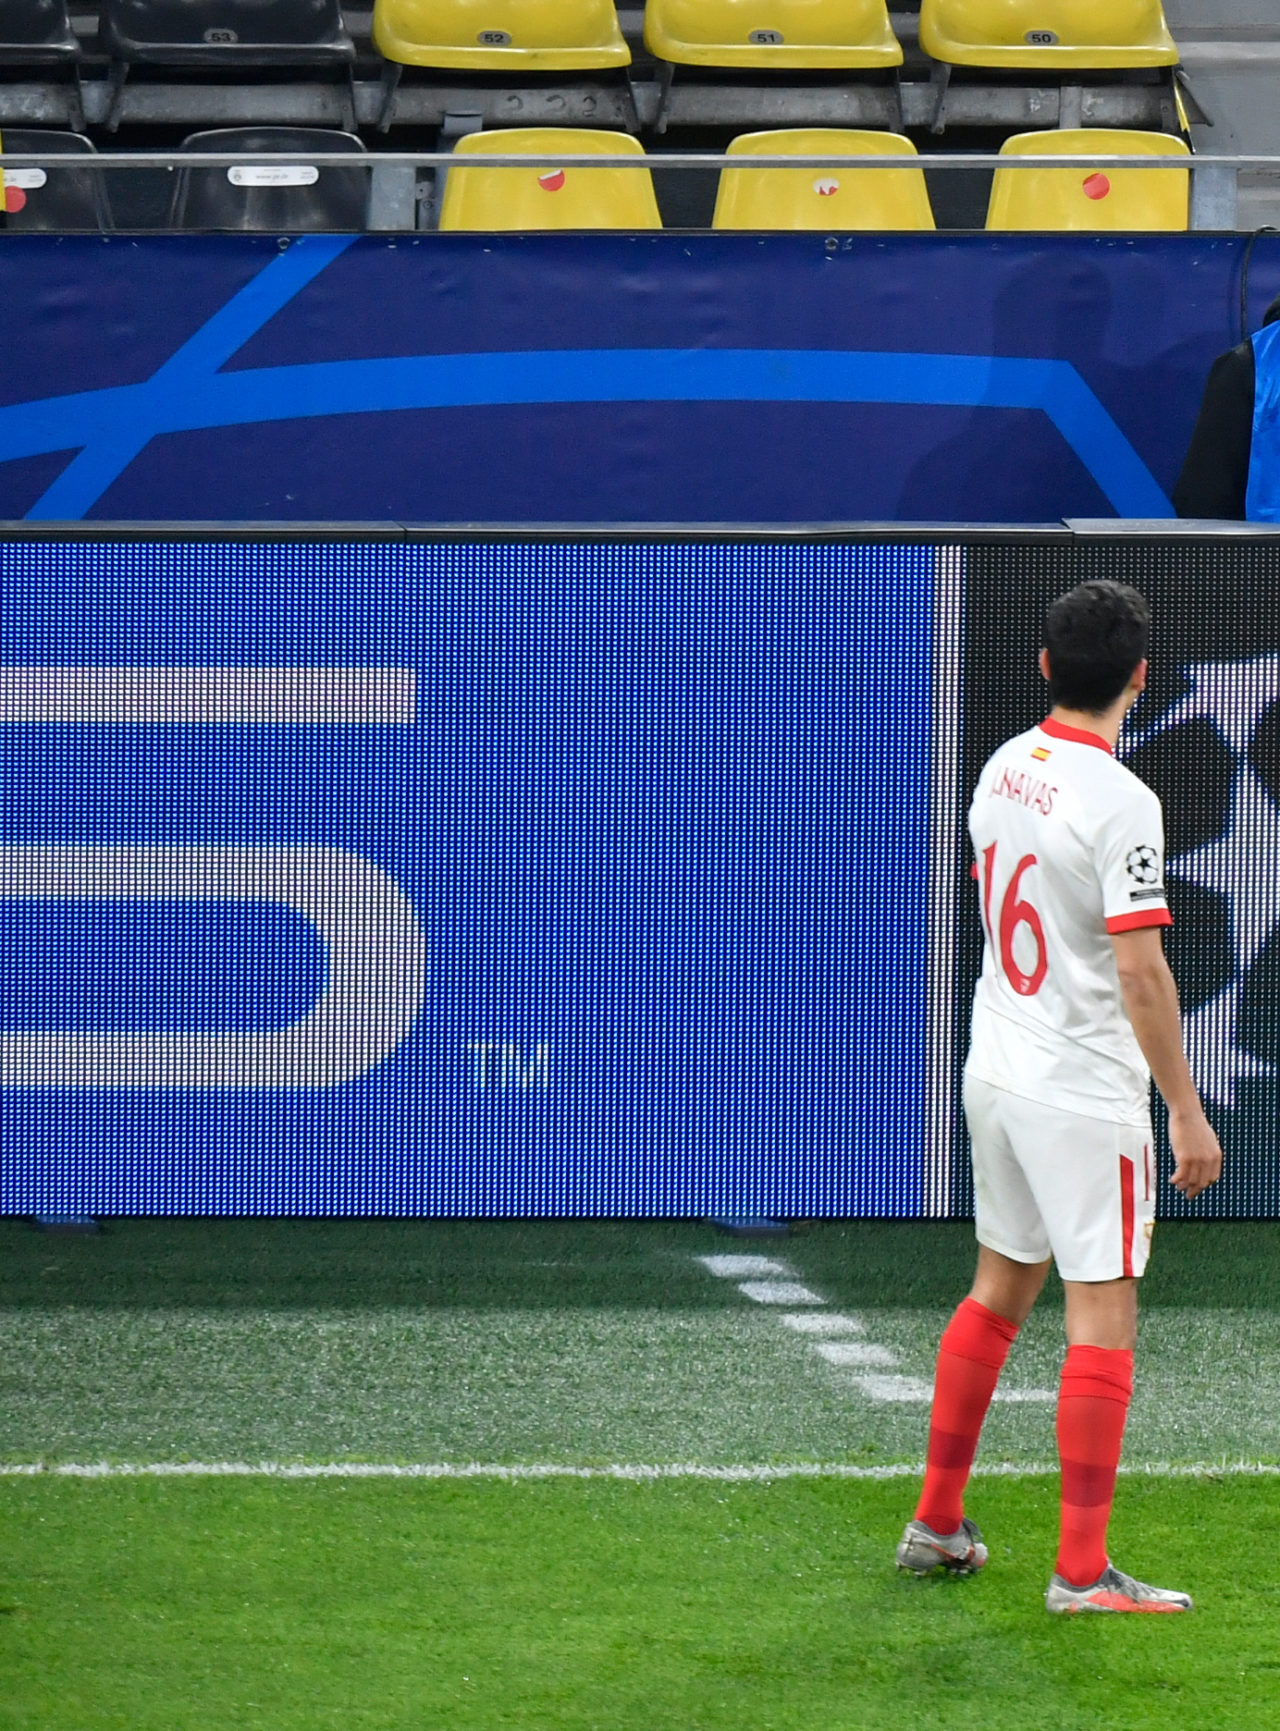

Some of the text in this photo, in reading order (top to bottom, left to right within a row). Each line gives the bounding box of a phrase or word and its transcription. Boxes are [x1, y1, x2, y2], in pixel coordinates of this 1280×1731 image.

[211, 32, 231, 43] 53
[484, 33, 504, 43] 52
[757, 33, 776, 43] 51
[1031, 33, 1052, 43] 50
[983, 839, 1049, 997] 16
